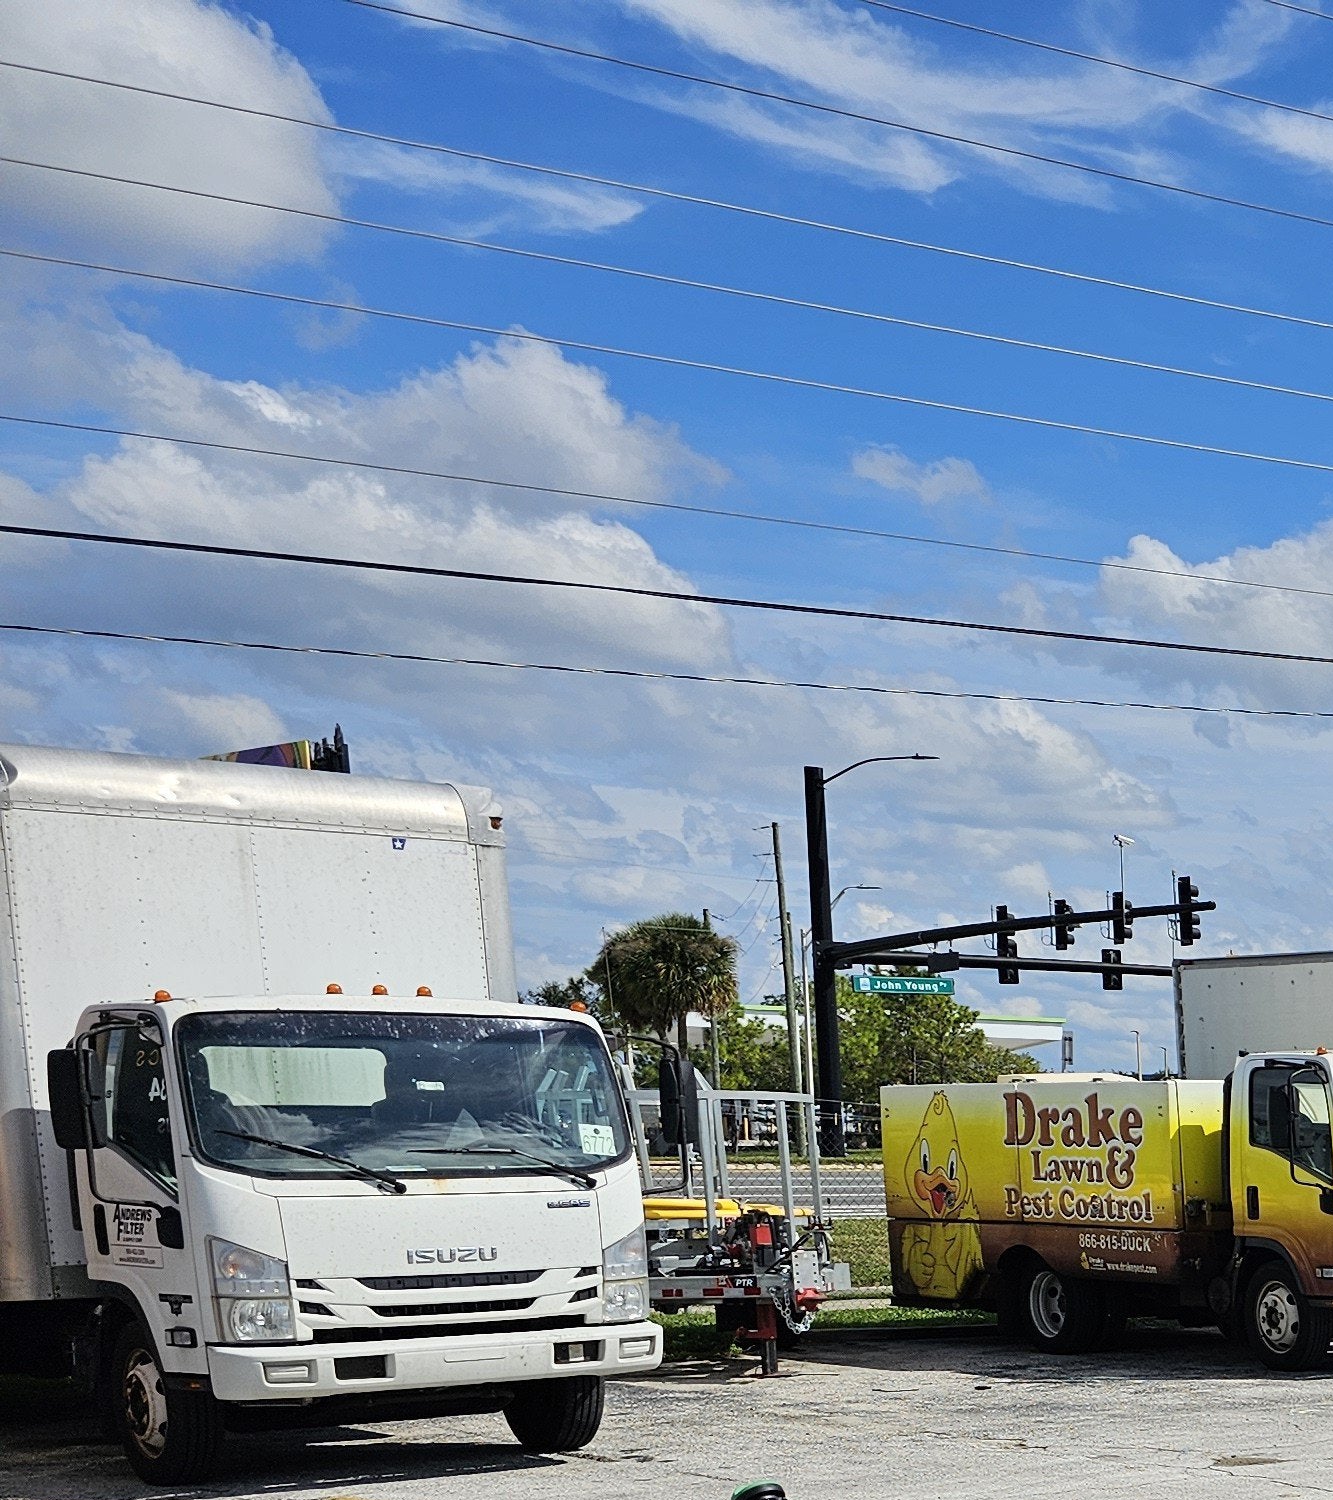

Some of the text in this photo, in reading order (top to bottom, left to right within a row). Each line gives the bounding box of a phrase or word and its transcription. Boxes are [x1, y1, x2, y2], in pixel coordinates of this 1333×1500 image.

[873, 981, 902, 990] John
[905, 981, 938, 992] Young
[1003, 1092, 1143, 1147] Drake
[583, 1135, 615, 1154] 6772
[1031, 1146, 1136, 1189] Lawn &
[113, 1204, 152, 1222] ANDREWS
[1005, 1187, 1153, 1222] Pest Control
[117, 1221, 144, 1241] FILTER
[1079, 1233, 1151, 1252] 866-815-DUCK
[407, 1247, 498, 1264] ISUZU
[736, 1279, 753, 1287] PTR
